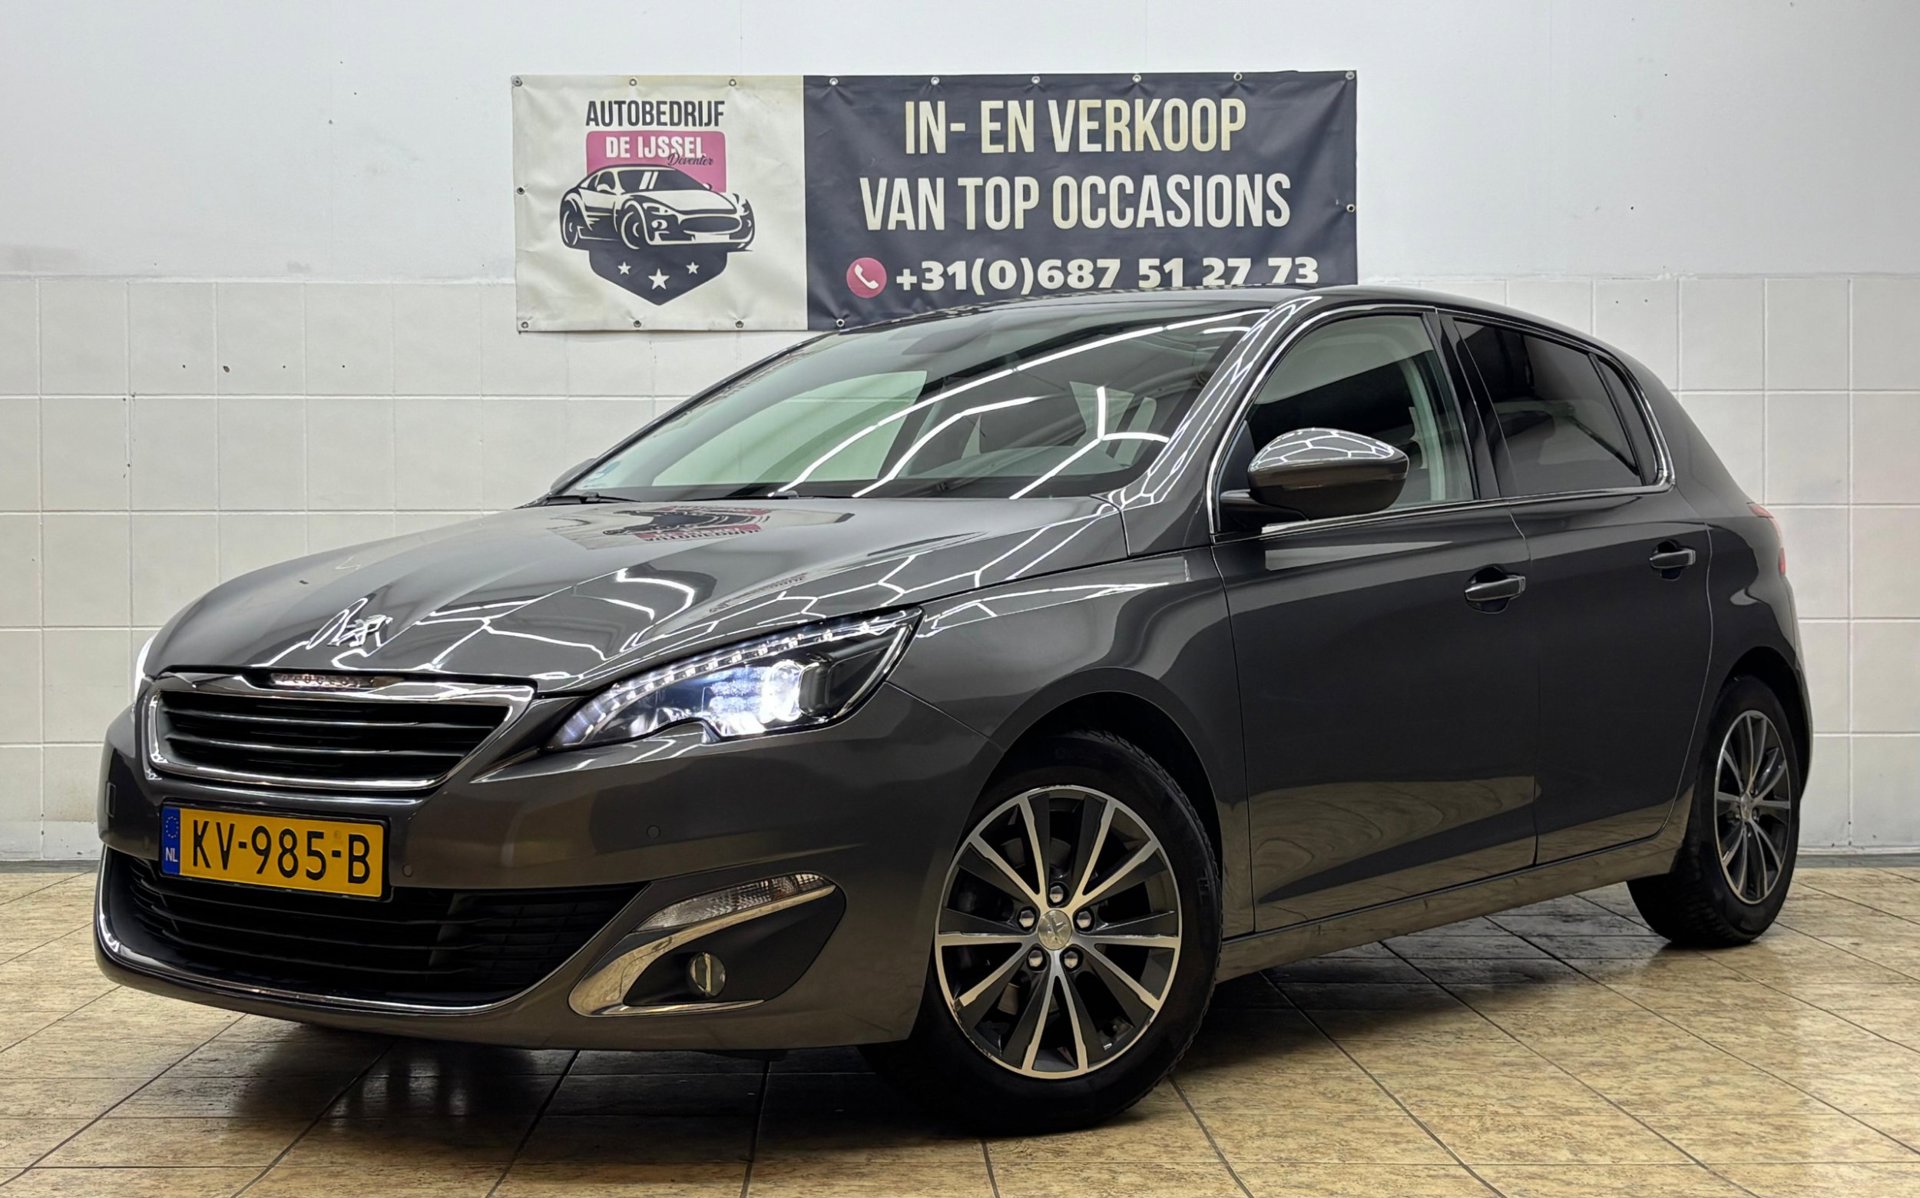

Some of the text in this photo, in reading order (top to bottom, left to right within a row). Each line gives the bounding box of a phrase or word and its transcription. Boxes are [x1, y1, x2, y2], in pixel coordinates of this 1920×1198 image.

[585, 100, 725, 127] AUTOBEDRIJF
[904, 97, 1247, 155] IN- EN VERKOOP
[605, 135, 706, 159] DE IJSSEL
[666, 151, 715, 167] Deventer
[859, 172, 1292, 232] VAN TOP OCCASIONS
[895, 256, 1319, 296] +31(0)687 51 27 73
[165, 847, 179, 863] NL
[192, 819, 371, 884] KV-985-B
